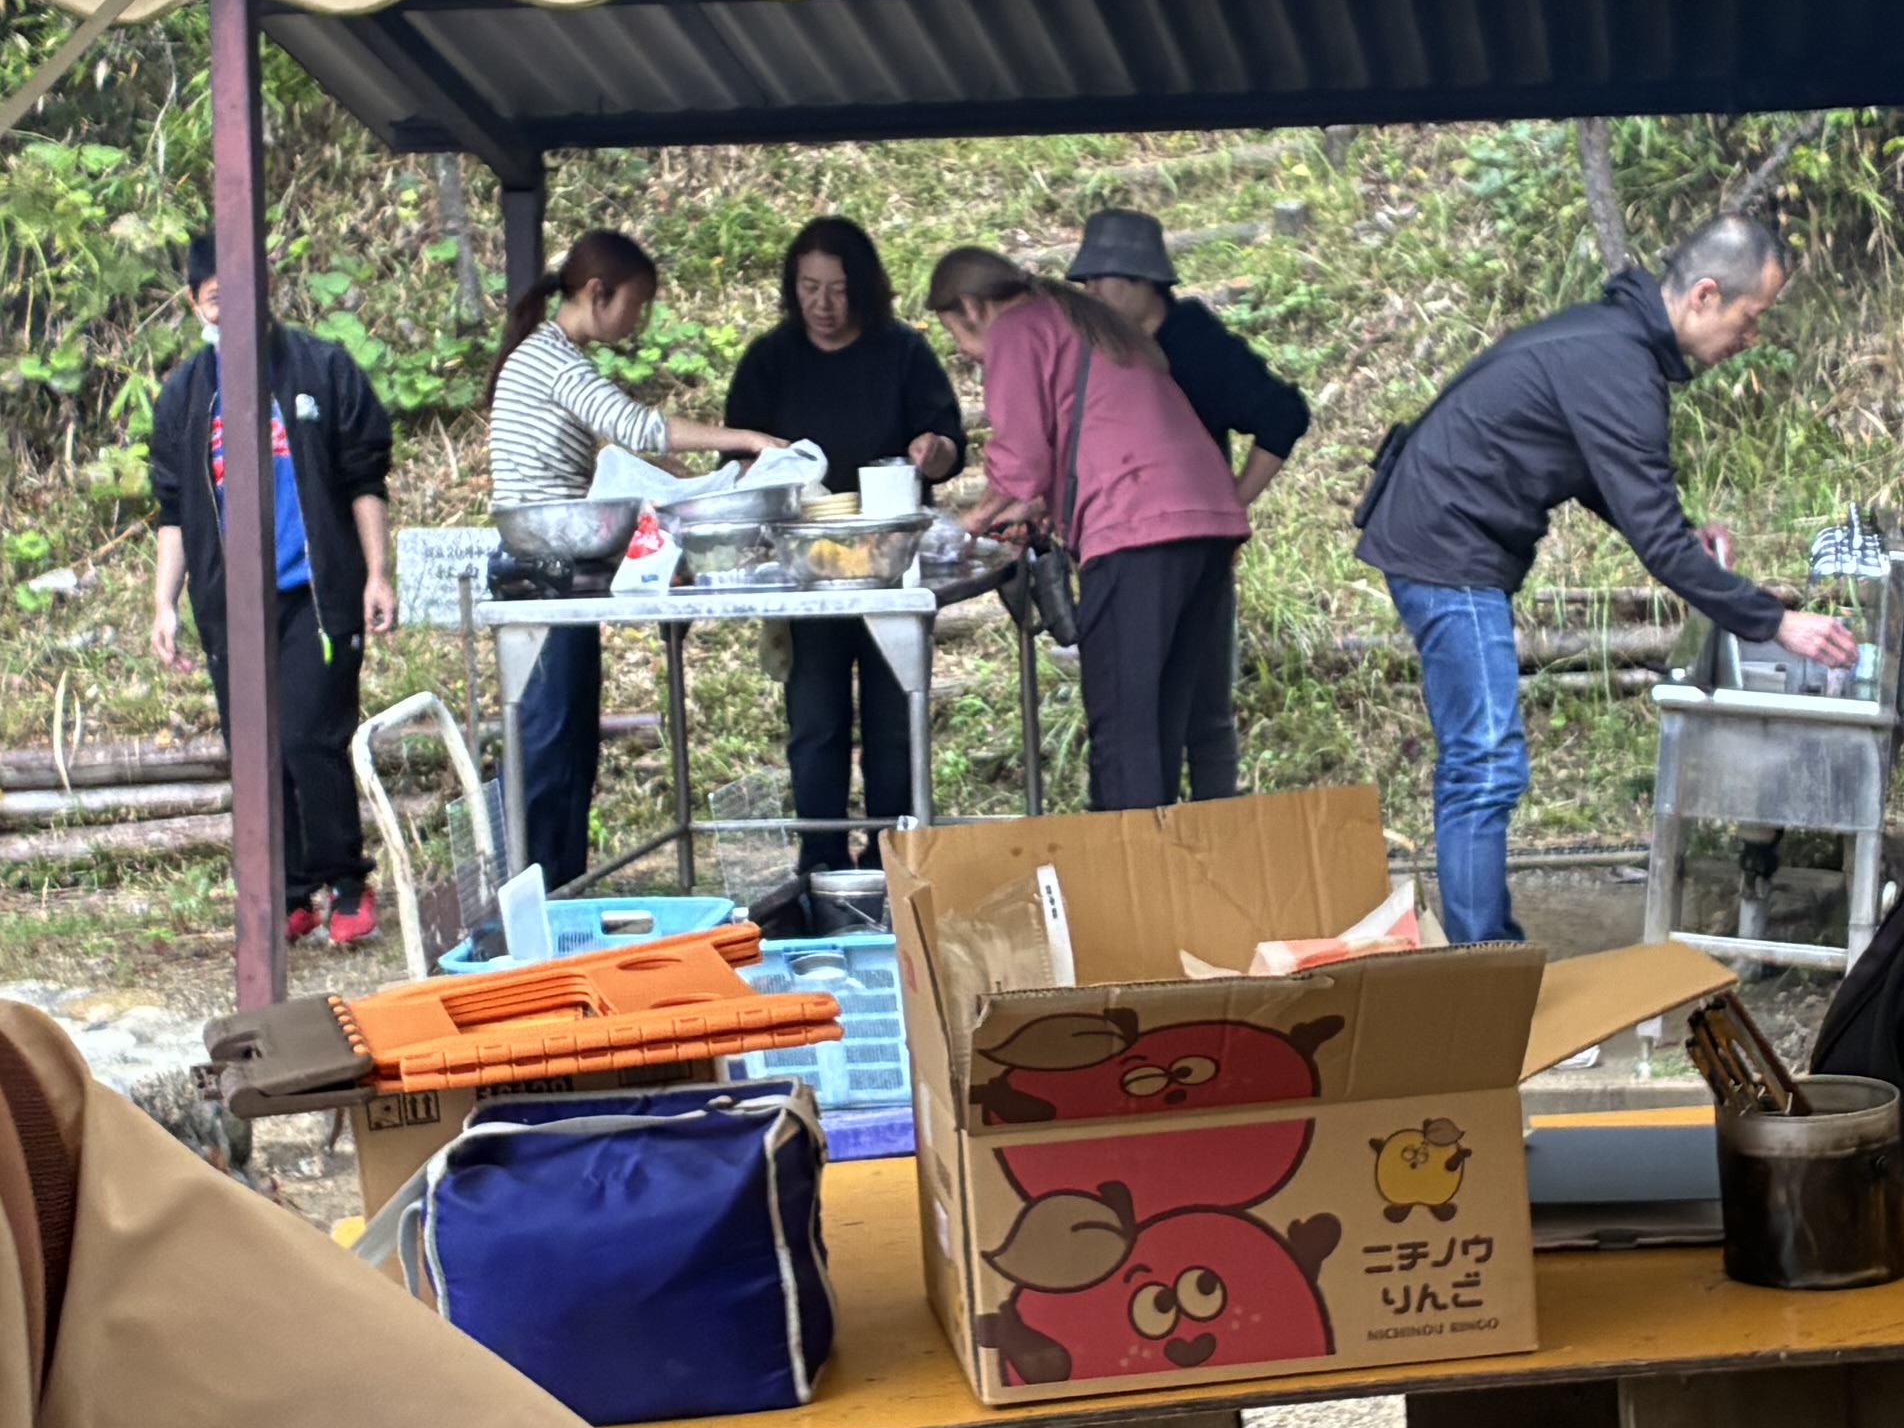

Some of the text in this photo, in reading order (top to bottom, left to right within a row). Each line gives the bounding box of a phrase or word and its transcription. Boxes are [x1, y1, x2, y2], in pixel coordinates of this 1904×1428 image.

[1362, 1234, 1494, 1274] ニチノウ
[1381, 1271, 1484, 1315] りんご
